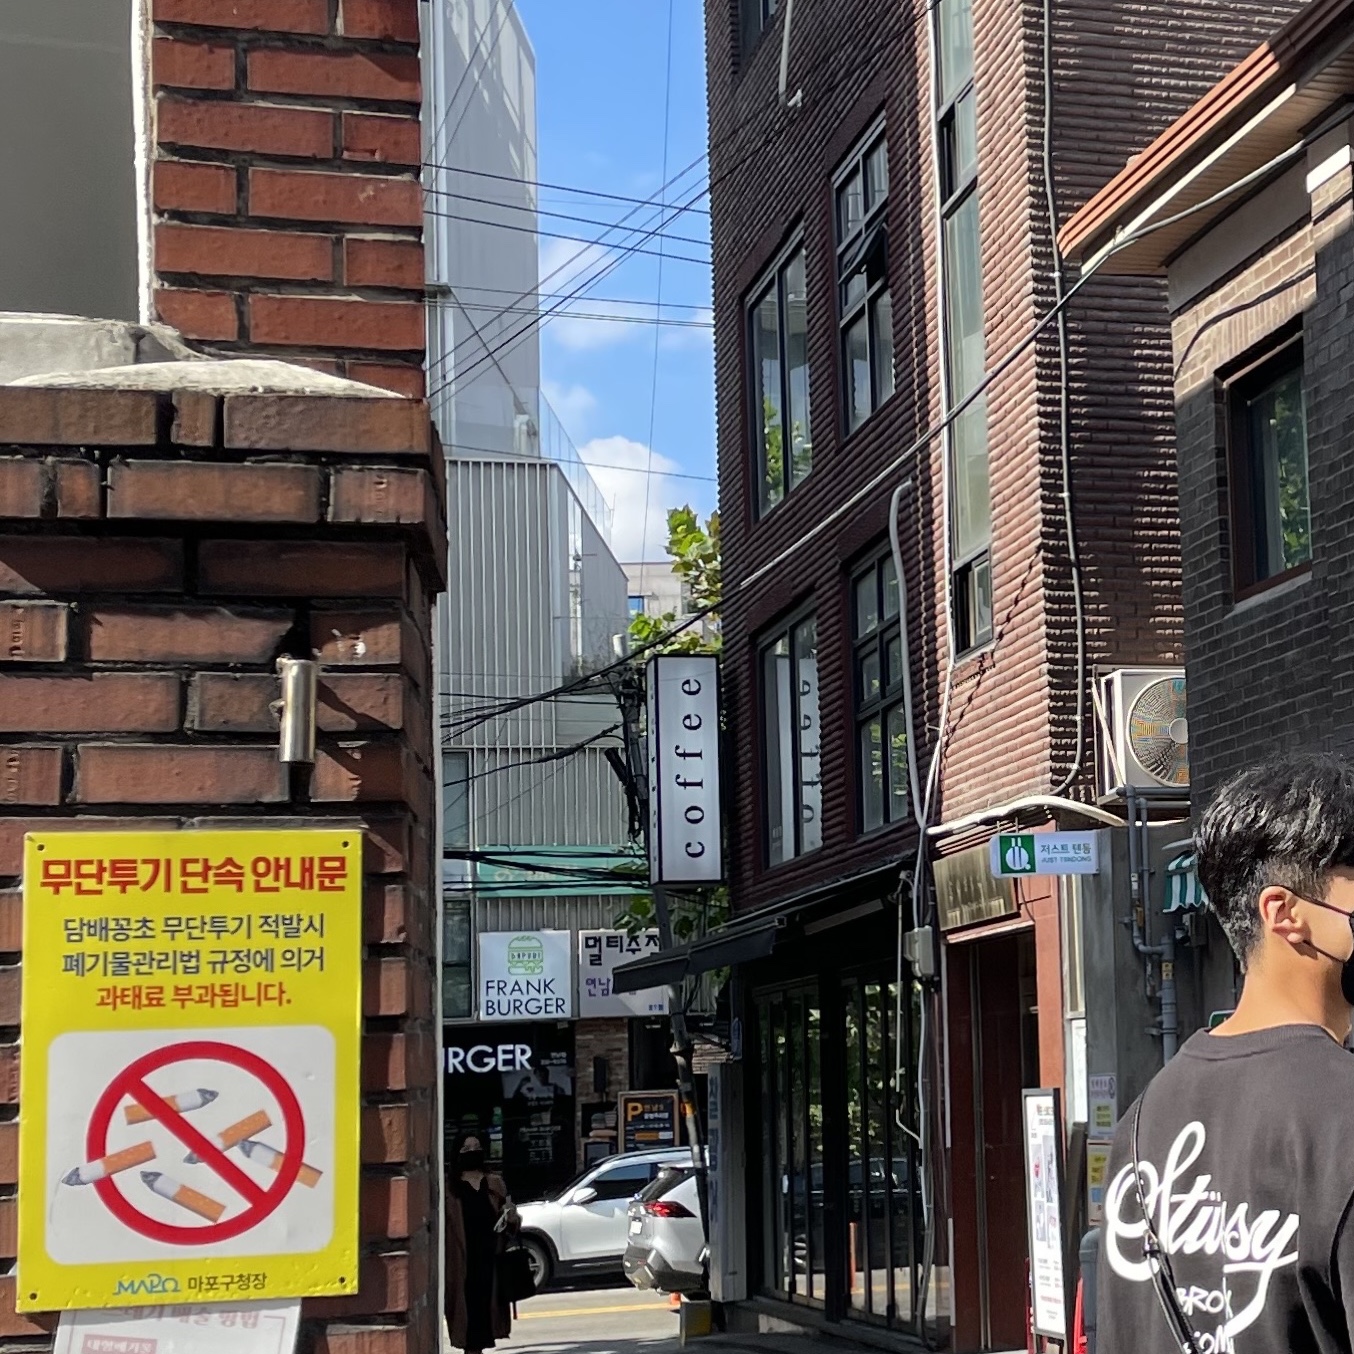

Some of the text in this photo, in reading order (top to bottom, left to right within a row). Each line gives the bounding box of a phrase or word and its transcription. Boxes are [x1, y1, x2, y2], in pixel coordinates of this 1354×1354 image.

[674, 678, 706, 859] coffee
[1040, 843, 1091, 855] 저스트 텐동
[40, 855, 348, 896] 무단투기 단속 안내문
[63, 912, 325, 944] 담배꽁초 무단투기 적발시
[62, 947, 325, 978] 폐기물관리법 규정에 의거
[96, 981, 292, 1011] 과태료 부과됩니다.
[486, 978, 555, 996] FRANK
[485, 998, 565, 1016] BURGER
[443, 1044, 532, 1074] RGER
[187, 1273, 268, 1292] 마포구청장
